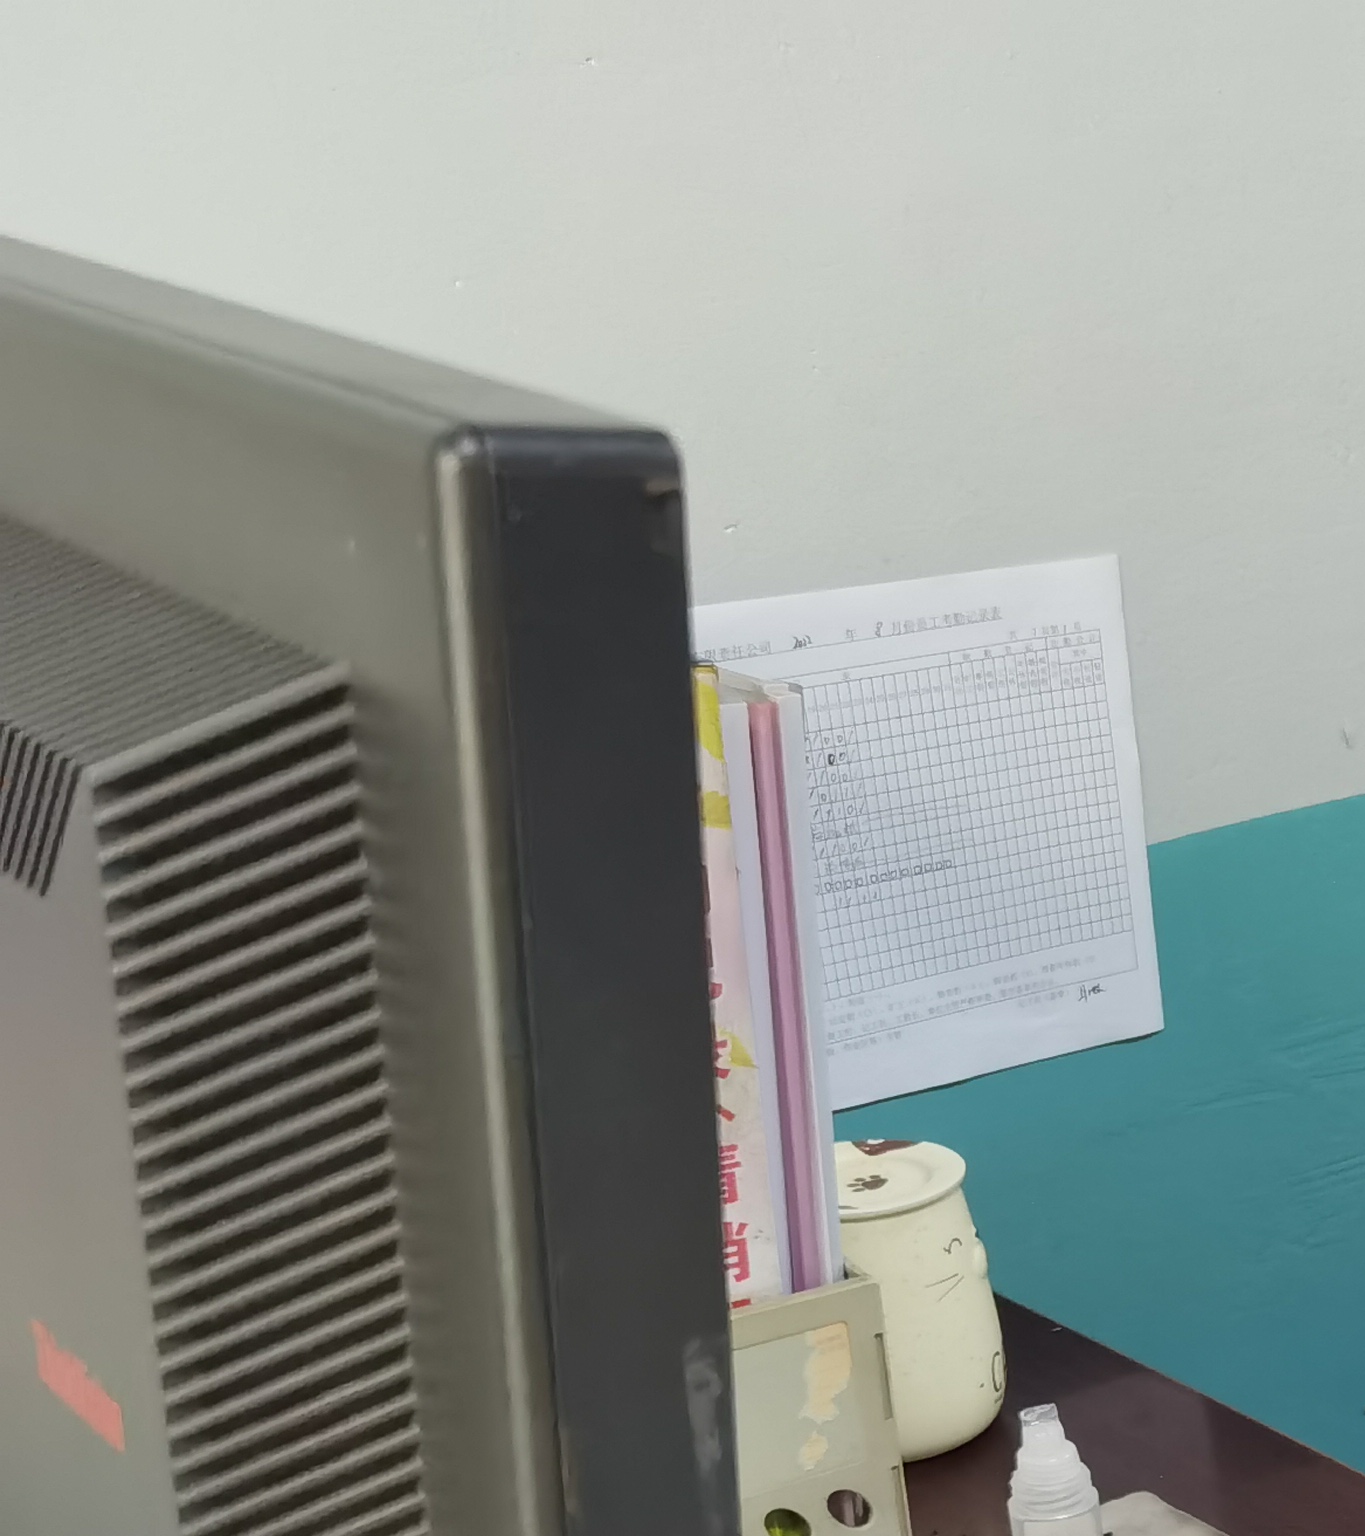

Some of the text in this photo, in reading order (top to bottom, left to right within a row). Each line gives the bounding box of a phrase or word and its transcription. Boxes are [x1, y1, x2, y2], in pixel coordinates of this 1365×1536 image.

[690, 639, 773, 664] 限责任公司
